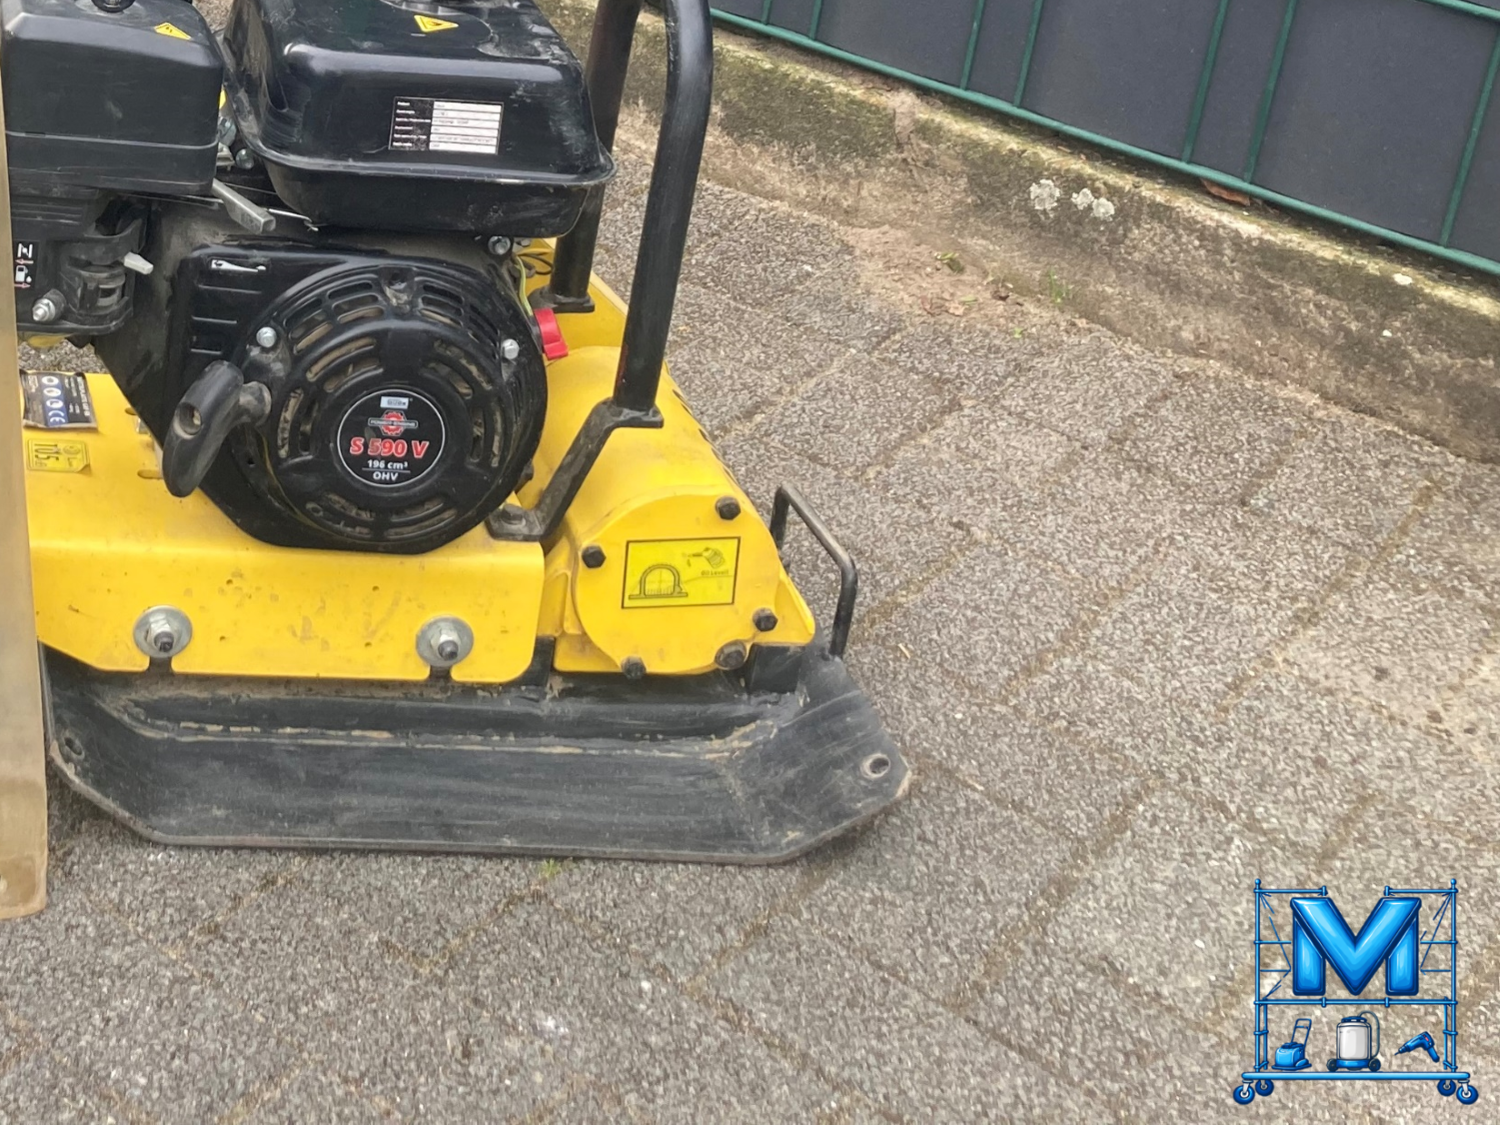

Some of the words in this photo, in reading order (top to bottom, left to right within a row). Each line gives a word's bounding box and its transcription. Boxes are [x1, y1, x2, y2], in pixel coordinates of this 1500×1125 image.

[349, 437, 365, 455] S
[367, 438, 408, 458] 590
[411, 440, 430, 459] V
[367, 459, 386, 469] 196
[372, 471, 399, 482] OHV
